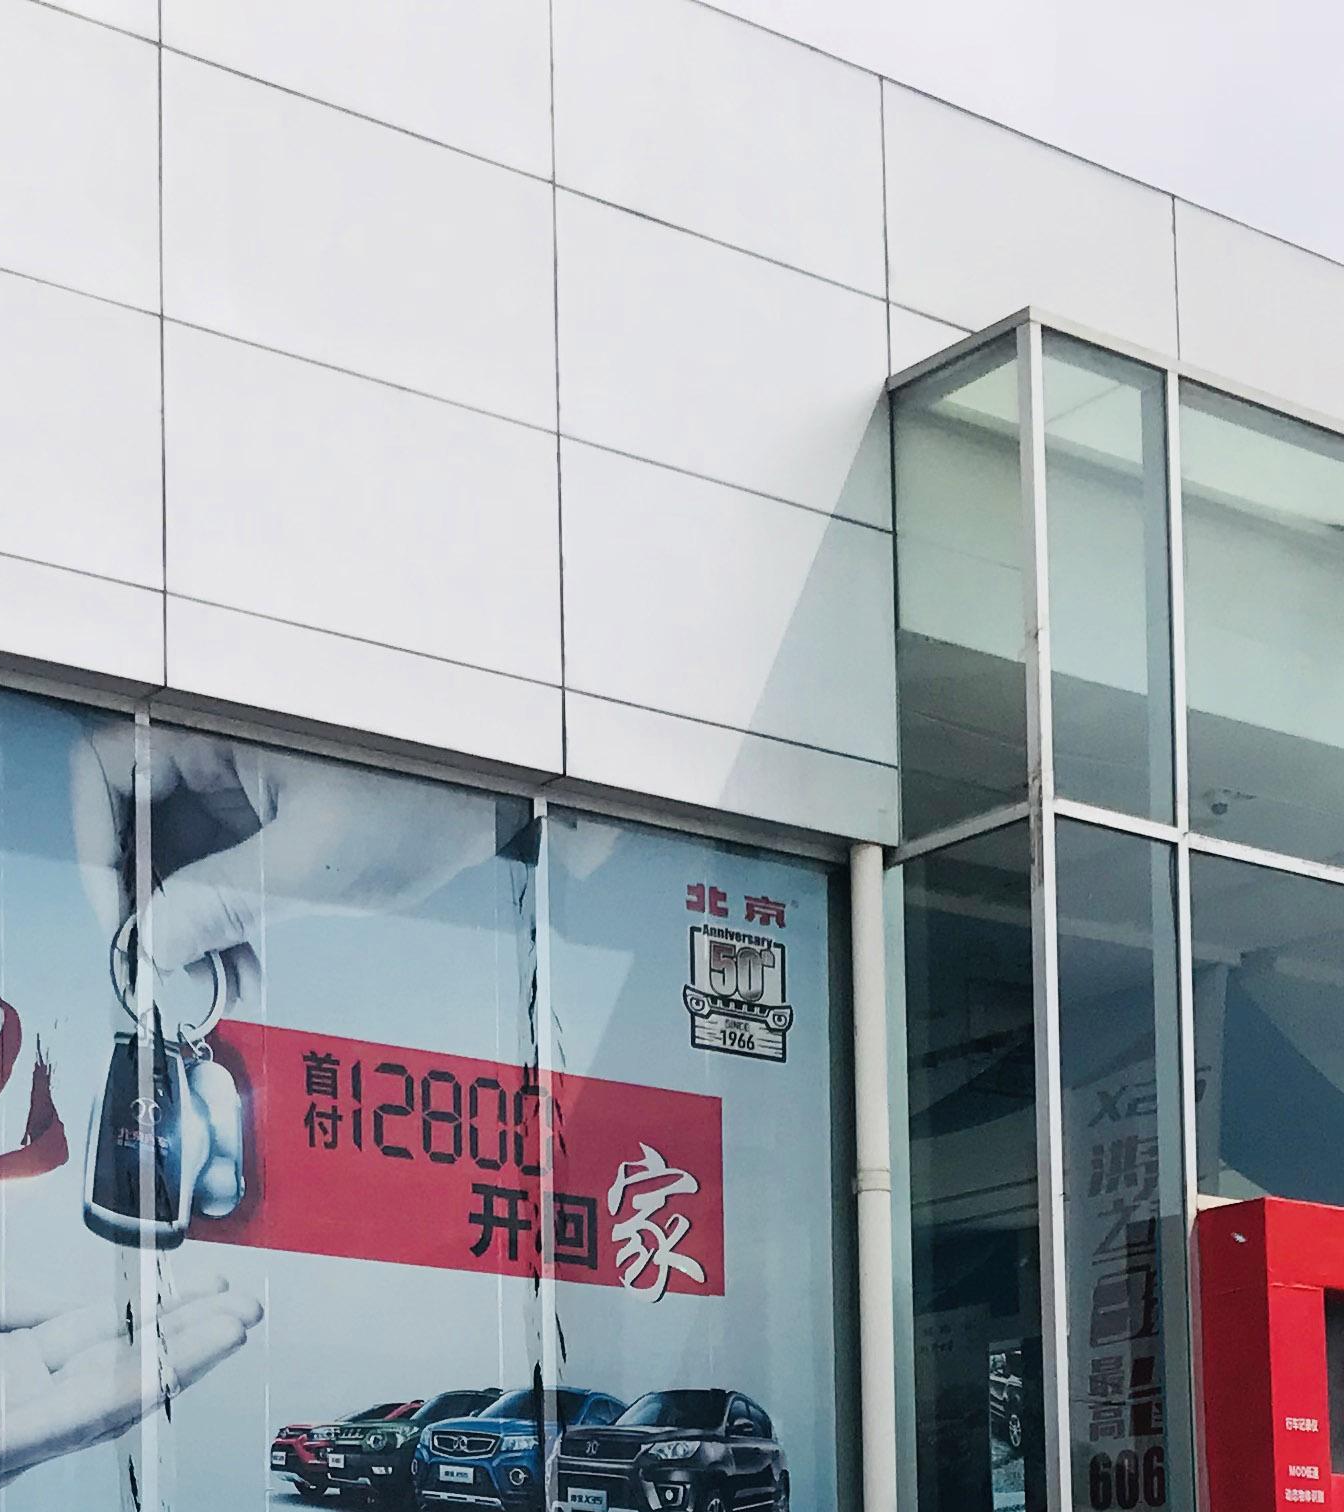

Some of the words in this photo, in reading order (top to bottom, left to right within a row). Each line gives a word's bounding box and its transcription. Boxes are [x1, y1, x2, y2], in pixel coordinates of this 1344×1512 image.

[686, 883, 786, 928] 北京
[702, 924, 773, 950] Anniversary
[720, 1030, 755, 1051] 1966
[351, 1060, 555, 1178] 12800
